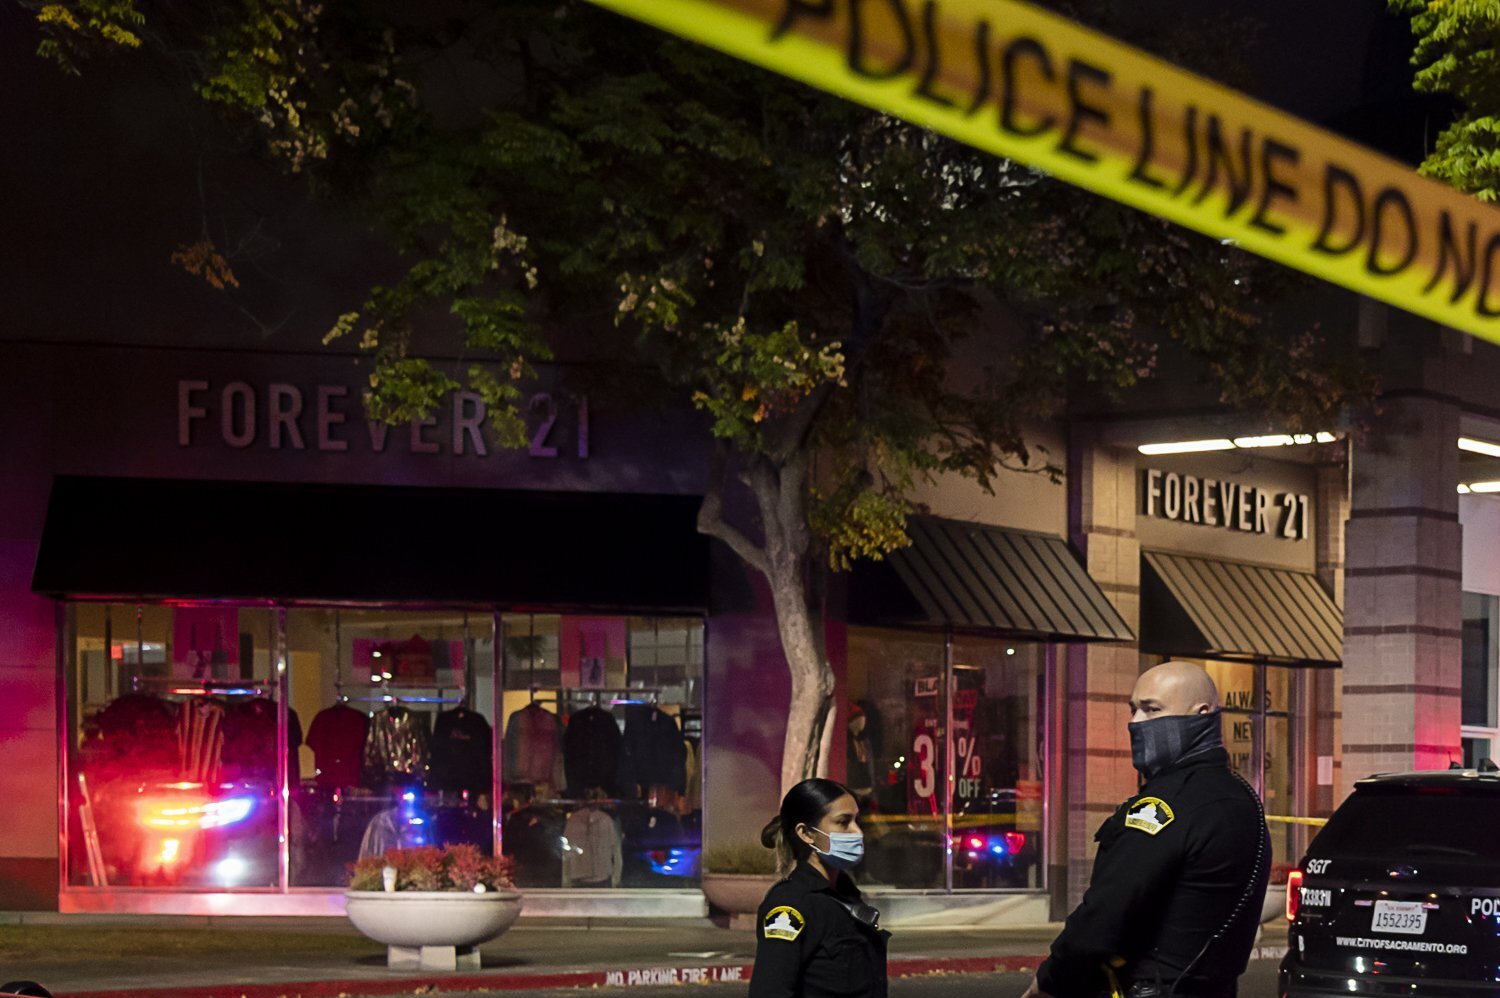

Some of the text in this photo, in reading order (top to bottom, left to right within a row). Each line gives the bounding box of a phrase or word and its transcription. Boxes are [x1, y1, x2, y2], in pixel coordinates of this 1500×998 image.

[1126, 87, 1299, 236] LINE
[1310, 163, 1419, 277] DO
[529, 391, 590, 458] 21
[1146, 469, 1309, 540] FOREVER 21
[958, 778, 981, 798] OFF
[1306, 859, 1332, 875] SGT
[1376, 912, 1422, 929] 1552395
[1336, 936, 1467, 955] WWW.CITYOFSACRAMENTO.ORG
[606, 967, 744, 985] NO PARKING FIRE LANE
